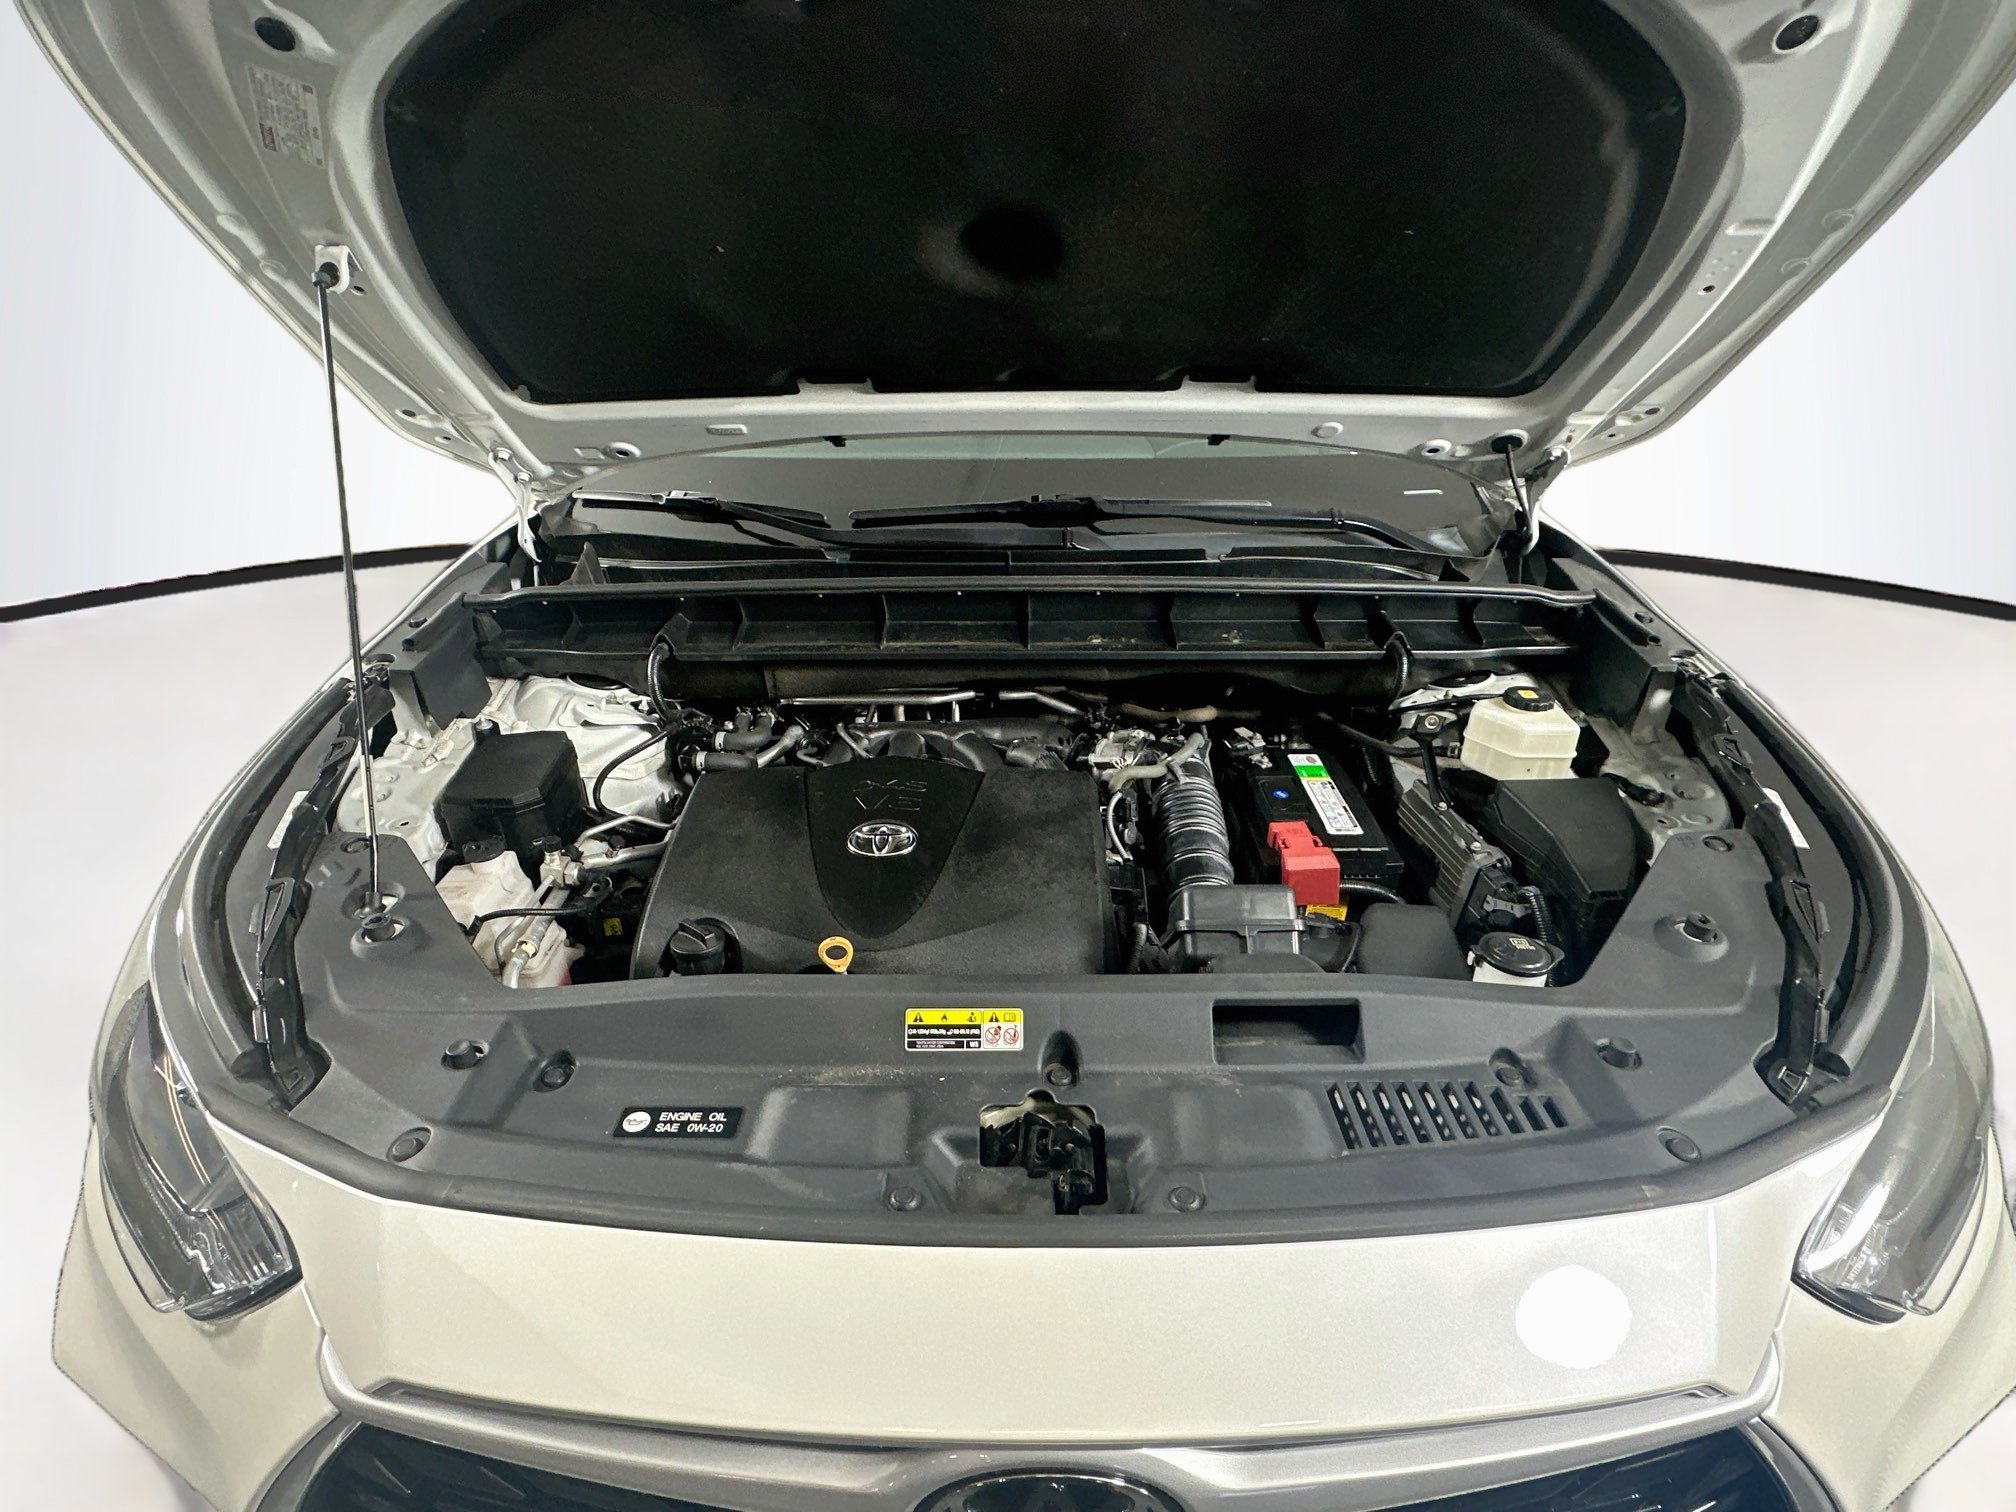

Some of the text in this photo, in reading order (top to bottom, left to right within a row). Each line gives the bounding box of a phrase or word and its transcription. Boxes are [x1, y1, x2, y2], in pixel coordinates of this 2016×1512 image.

[659, 1111, 728, 1122] ENGINE OIL
[654, 1122, 724, 1133] SAE 0W-20
